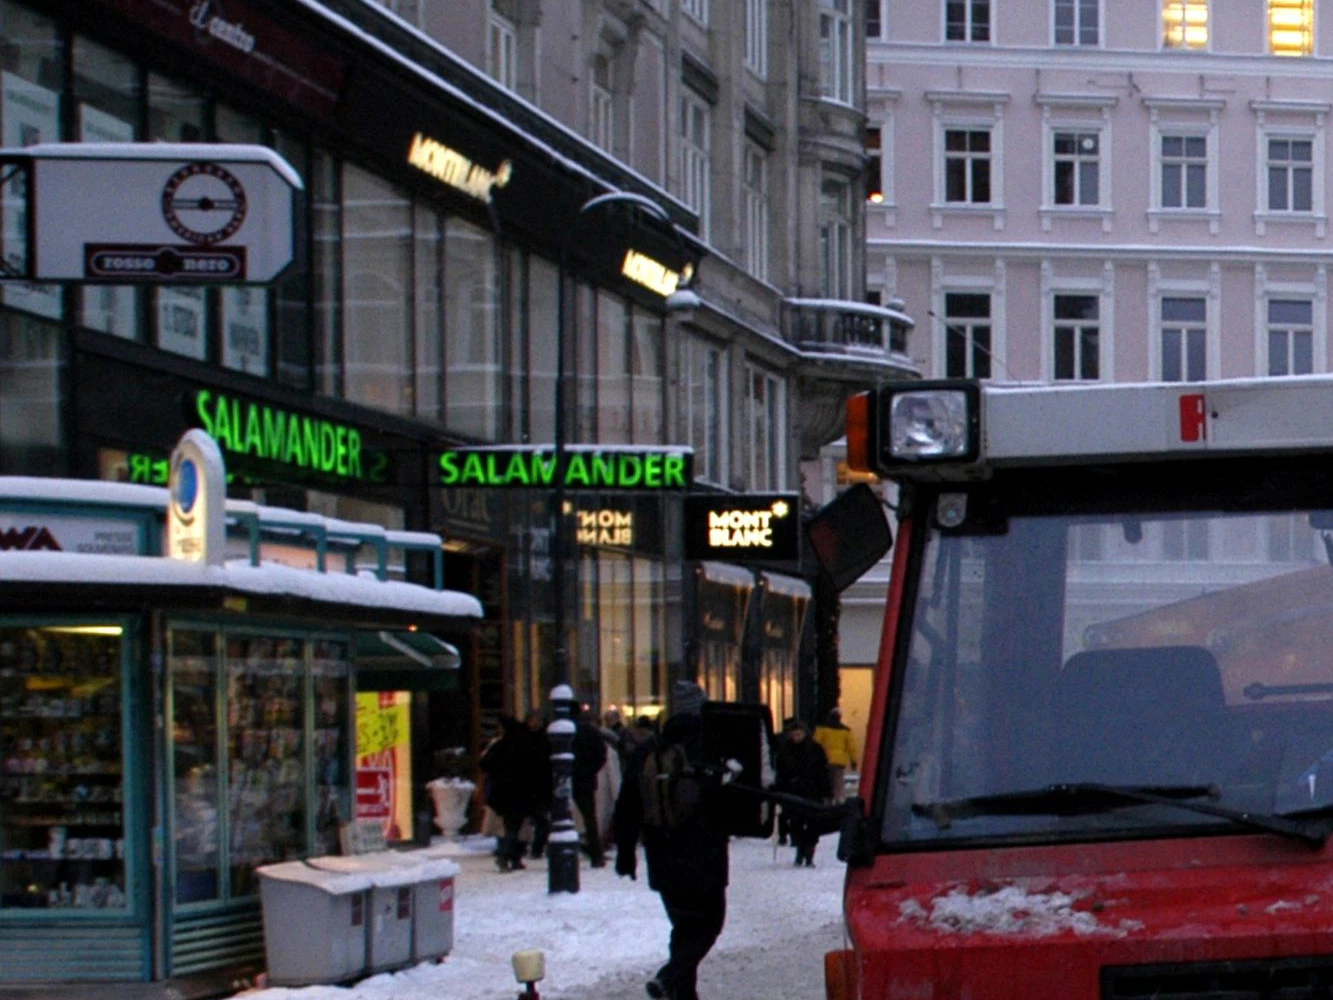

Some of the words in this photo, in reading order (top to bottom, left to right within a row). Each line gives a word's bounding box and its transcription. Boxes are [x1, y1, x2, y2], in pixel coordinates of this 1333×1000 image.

[103, 257, 156, 271] rosso
[183, 258, 230, 272] nero
[196, 388, 362, 478] SALAMANDER
[439, 452, 687, 487] SALAMANDER
[708, 510, 772, 529] MONT
[708, 529, 773, 547] BLANC
